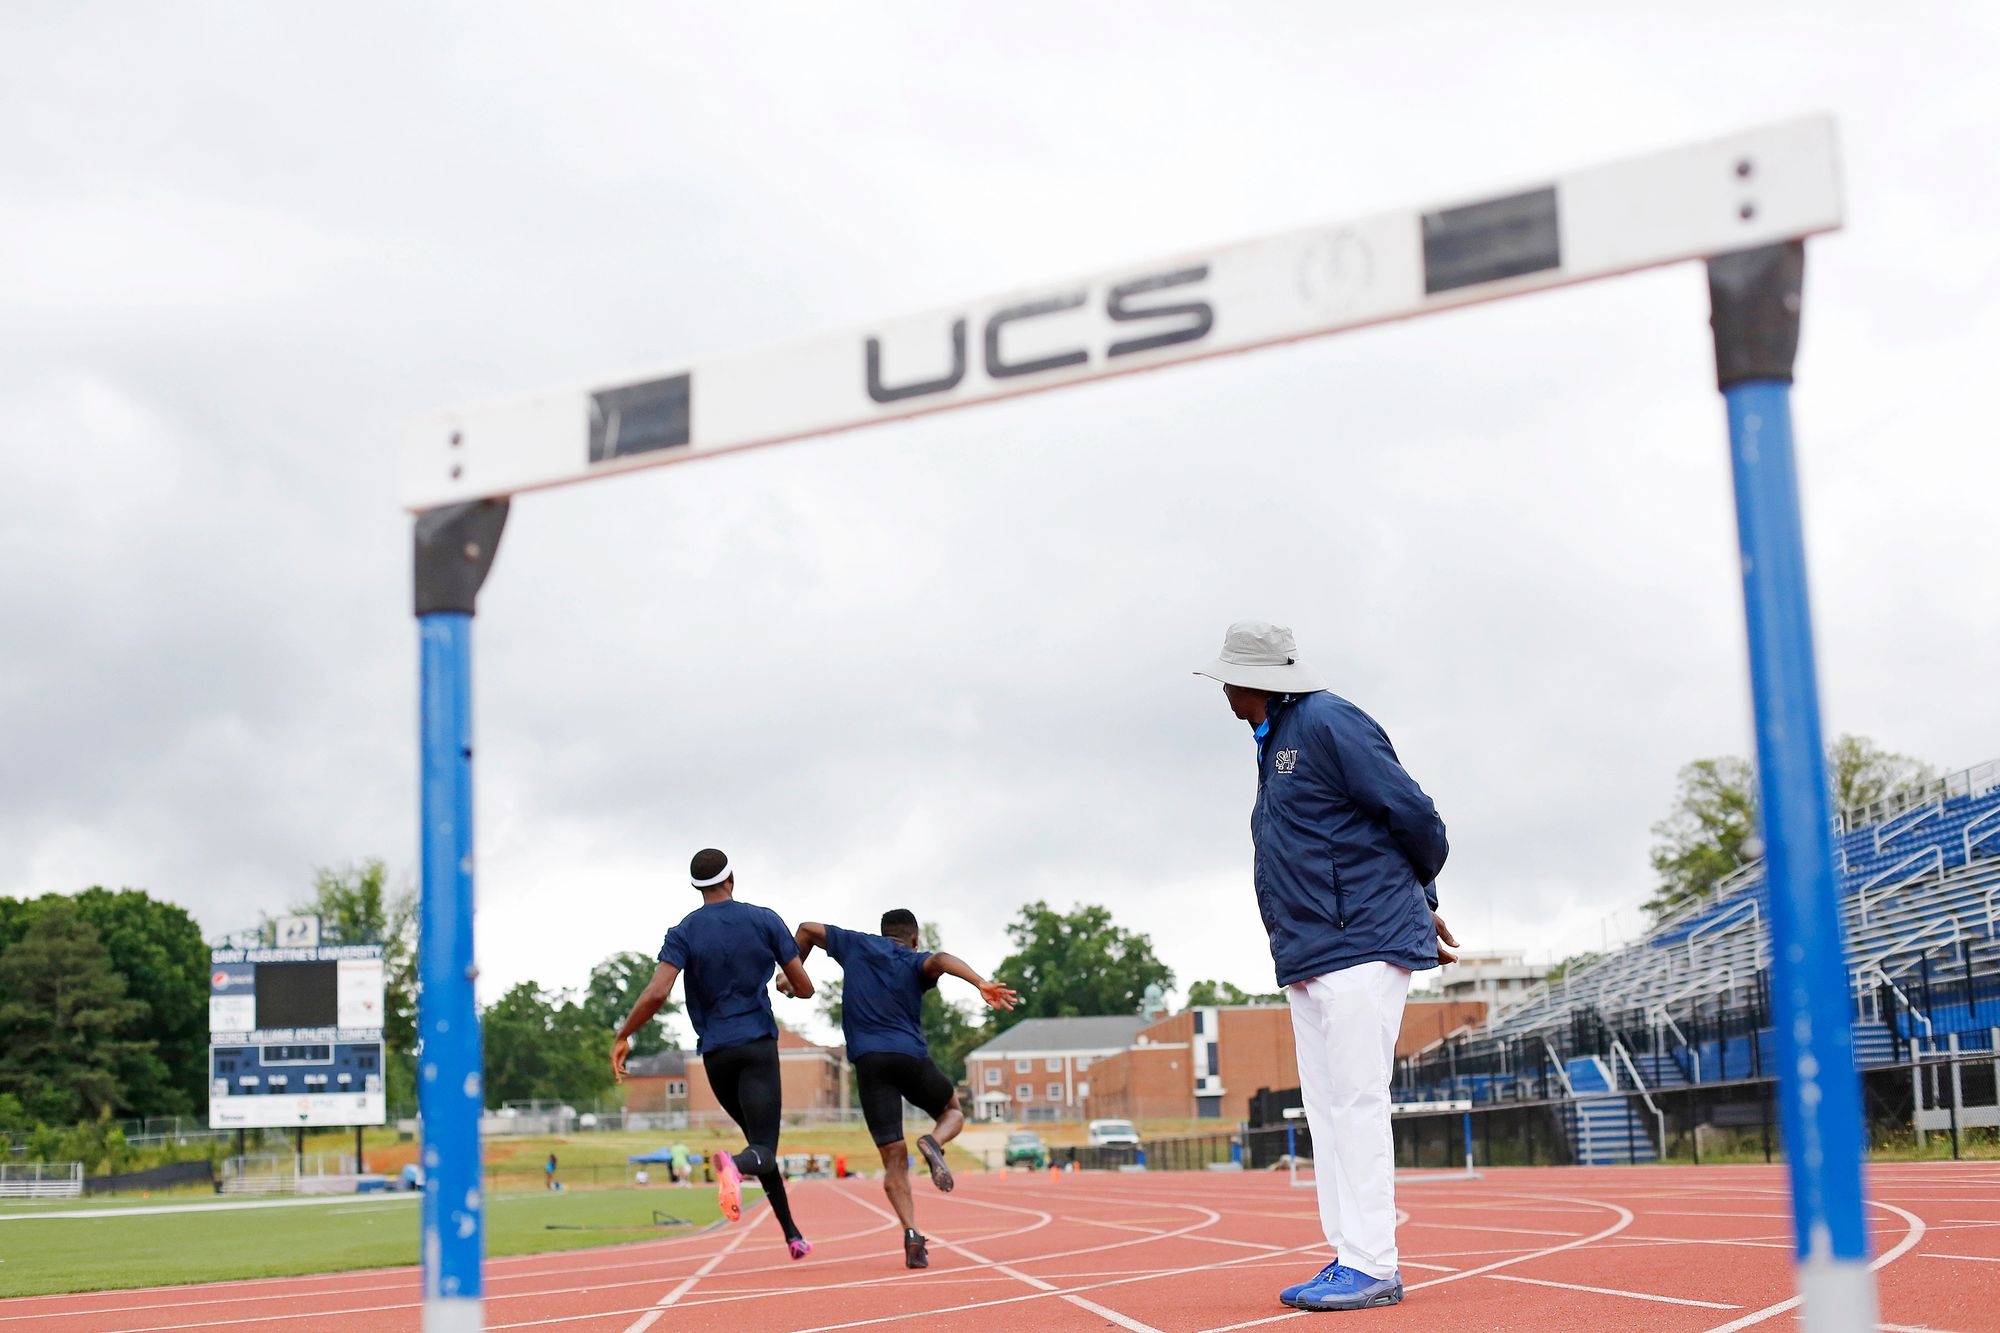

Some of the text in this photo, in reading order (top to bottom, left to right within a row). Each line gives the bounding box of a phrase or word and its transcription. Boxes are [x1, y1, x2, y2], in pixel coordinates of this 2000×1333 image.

[866, 265, 1213, 404] UCS
[212, 949, 246, 963] SAINT
[318, 945, 383, 960] UNIVERSITY
[211, 1031, 249, 1044] GEORGE
[248, 1029, 294, 1043] WILLIAMS
[294, 1028, 337, 1042] ATHLETIC
